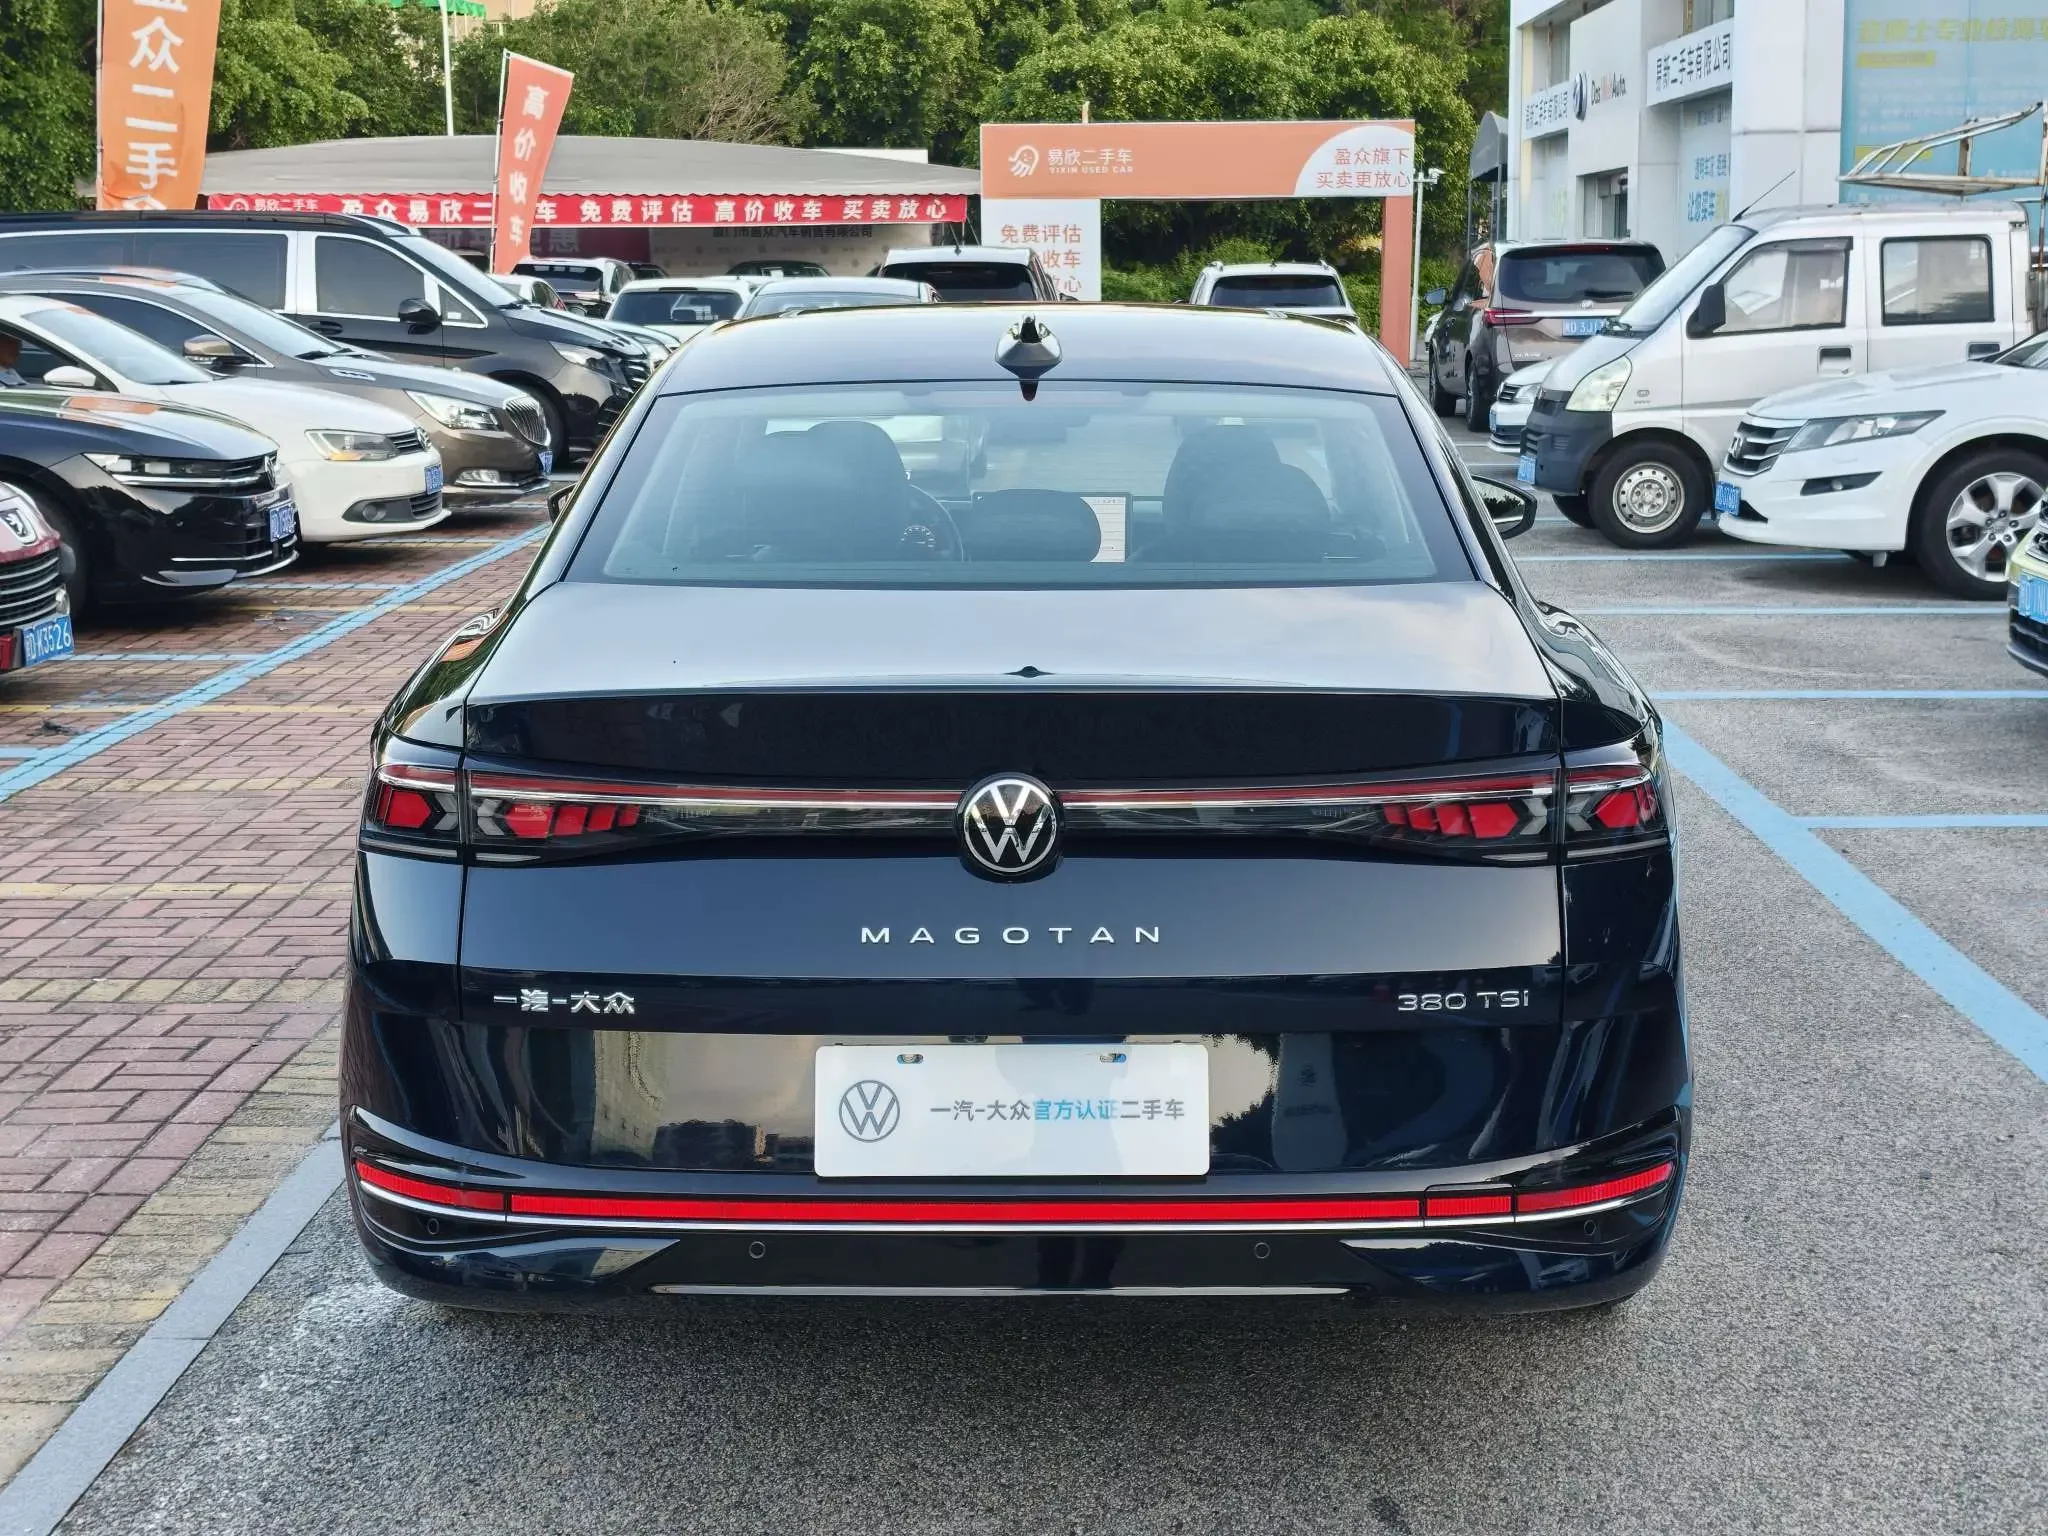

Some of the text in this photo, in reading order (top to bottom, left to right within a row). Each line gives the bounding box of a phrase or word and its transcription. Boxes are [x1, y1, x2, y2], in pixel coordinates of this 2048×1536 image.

[125, 0, 188, 210] 众二手
[509, 84, 550, 247] 高价收车
[1047, 148, 1133, 166] 易欣二手车
[1335, 147, 1410, 165] 盈众旗下
[1082, 166, 1109, 174] USED
[1112, 166, 1134, 174] CAR
[1316, 169, 1411, 189] 买卖更放心
[341, 199, 557, 225] 盈众易欣二车
[579, 199, 693, 223] 免费评估
[714, 199, 823, 222] 高价收车
[842, 199, 948, 220] 买卖放心
[1001, 223, 1083, 244] 免费评估
[860, 926, 1161, 945] MAGOTAN
[1397, 993, 1467, 1011] 380
[930, 1098, 1185, 1122] 一汽-大众官方认证二手车
